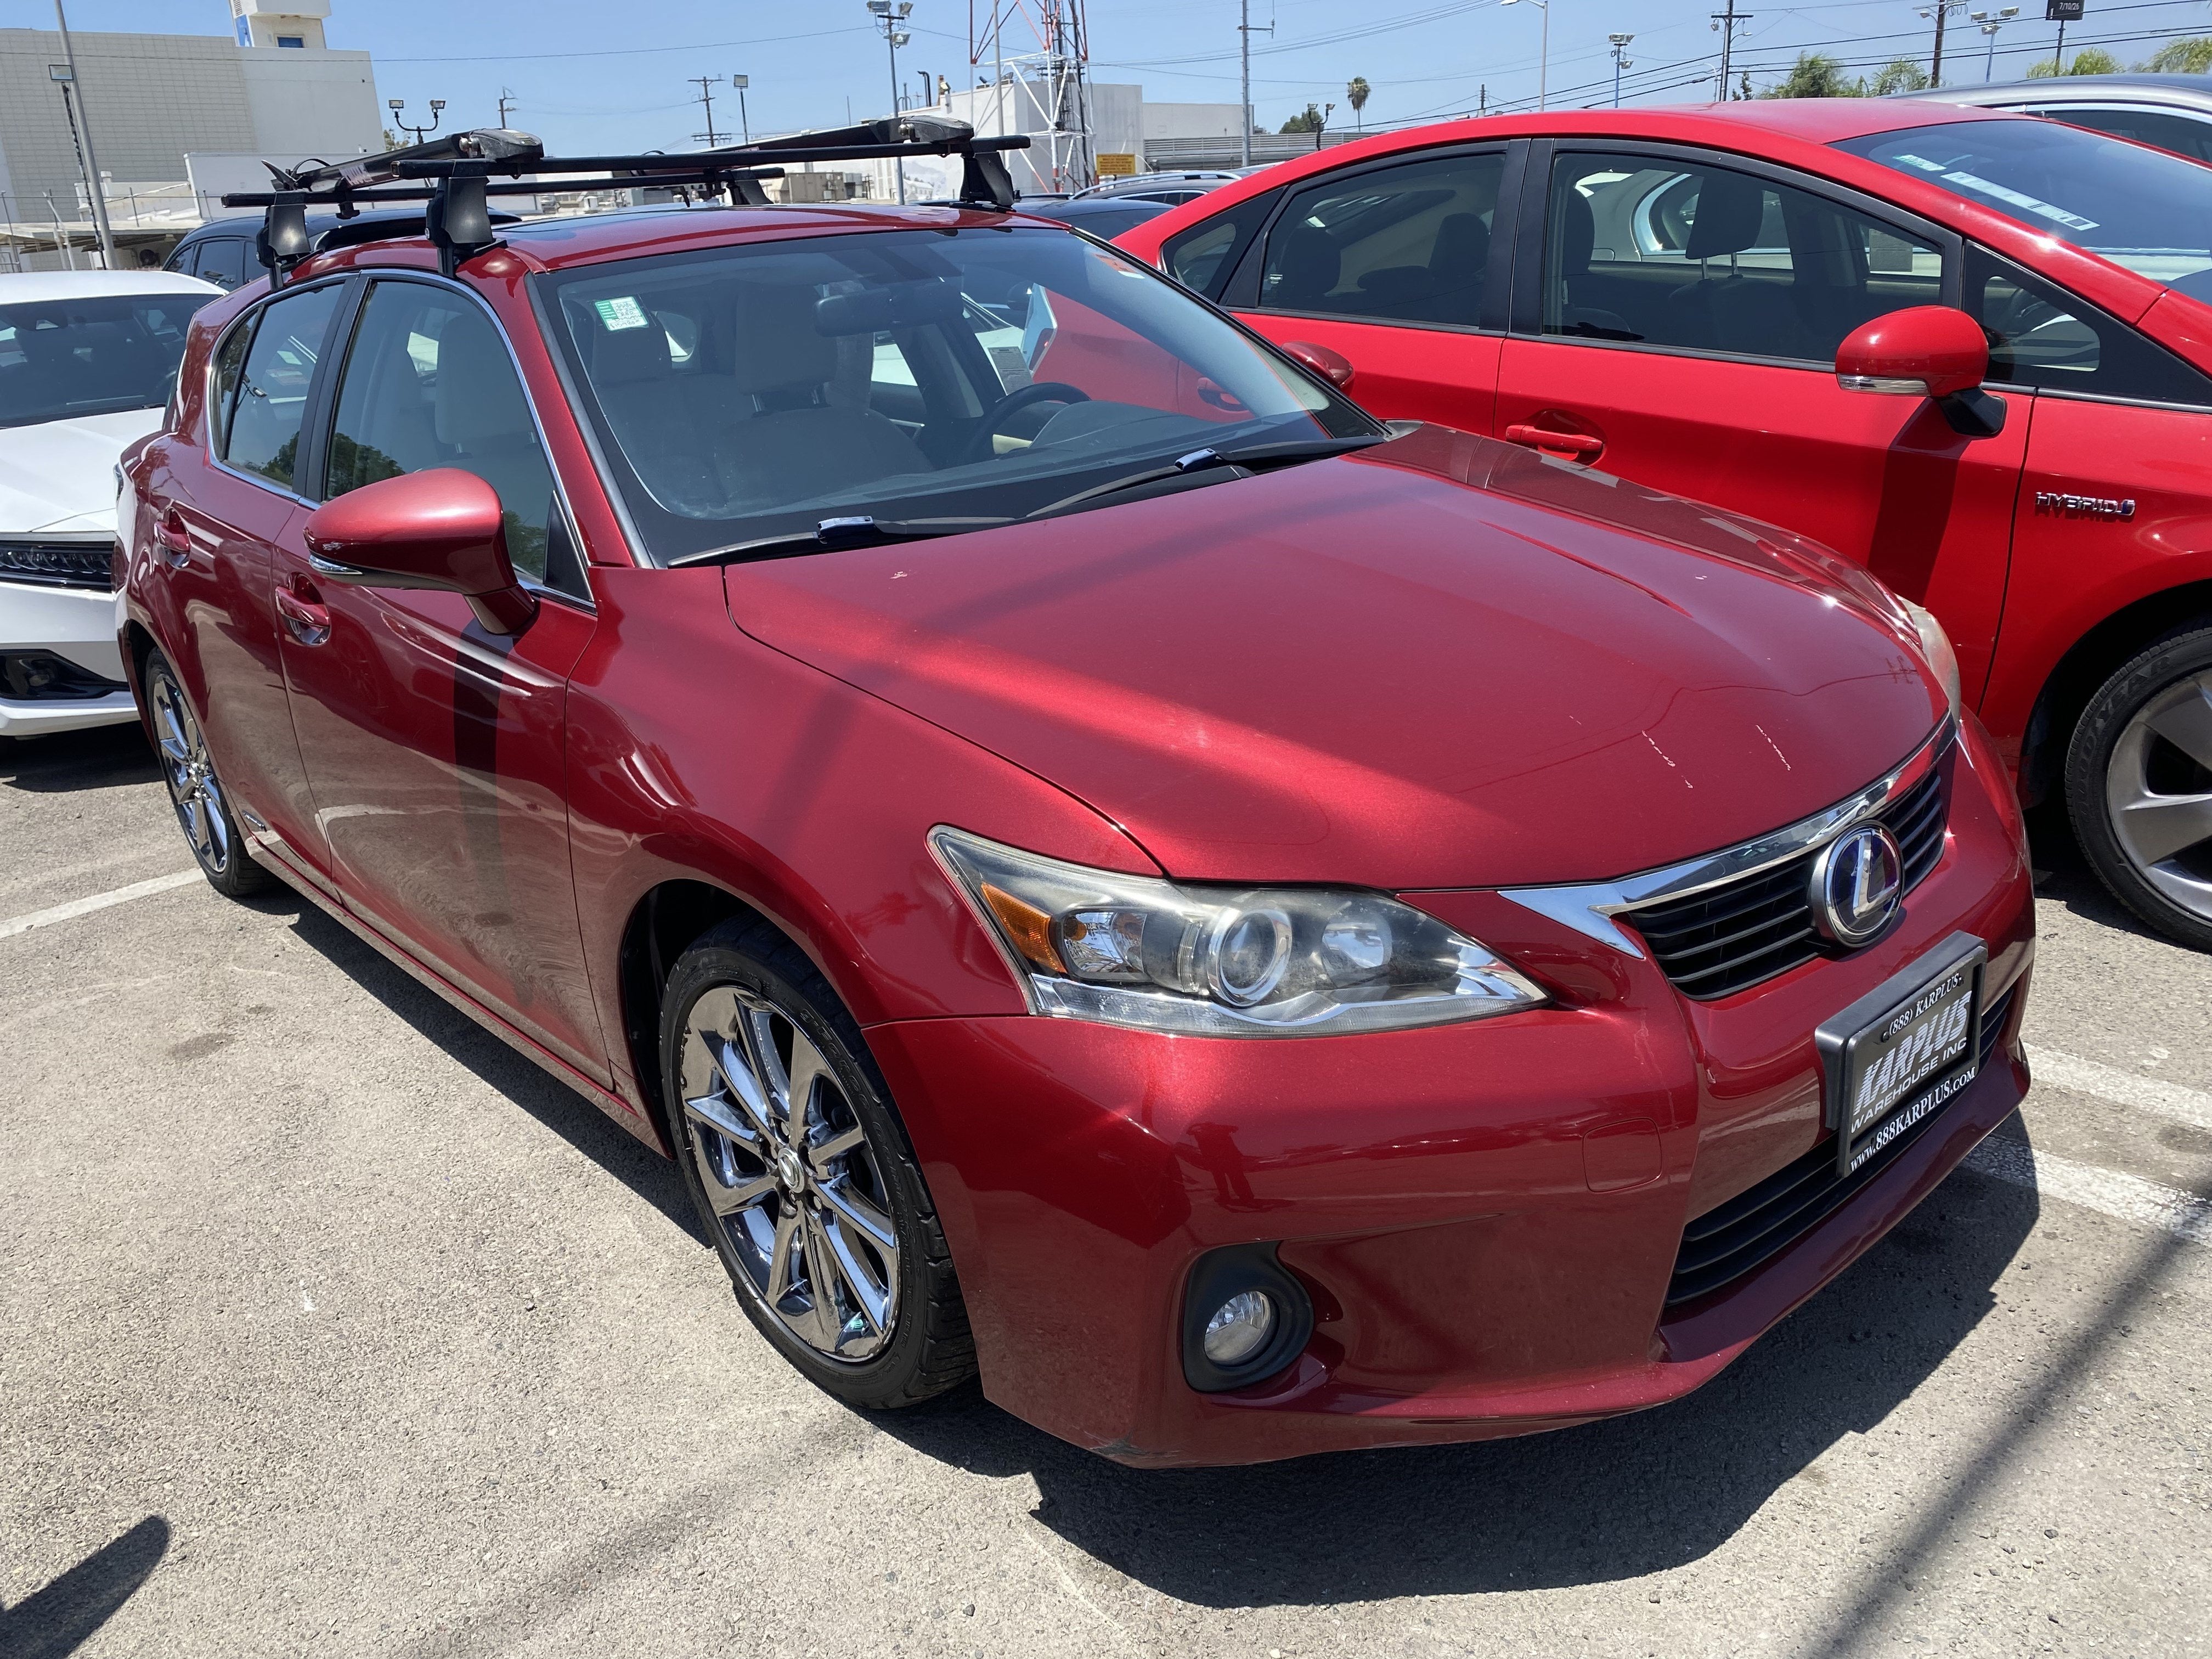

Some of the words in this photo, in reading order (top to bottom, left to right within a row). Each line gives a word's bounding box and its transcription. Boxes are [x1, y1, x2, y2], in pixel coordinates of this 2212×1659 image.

[2036, 492, 2118, 513] HYBRID
[1889, 1009, 1912, 1035] (888)
[1915, 973, 1959, 1018] KARPLUS
[1851, 1056, 1938, 1133] WAREHOUSE
[1943, 1037, 1967, 1060] INC
[1853, 991, 1972, 1116] KARPLUS
